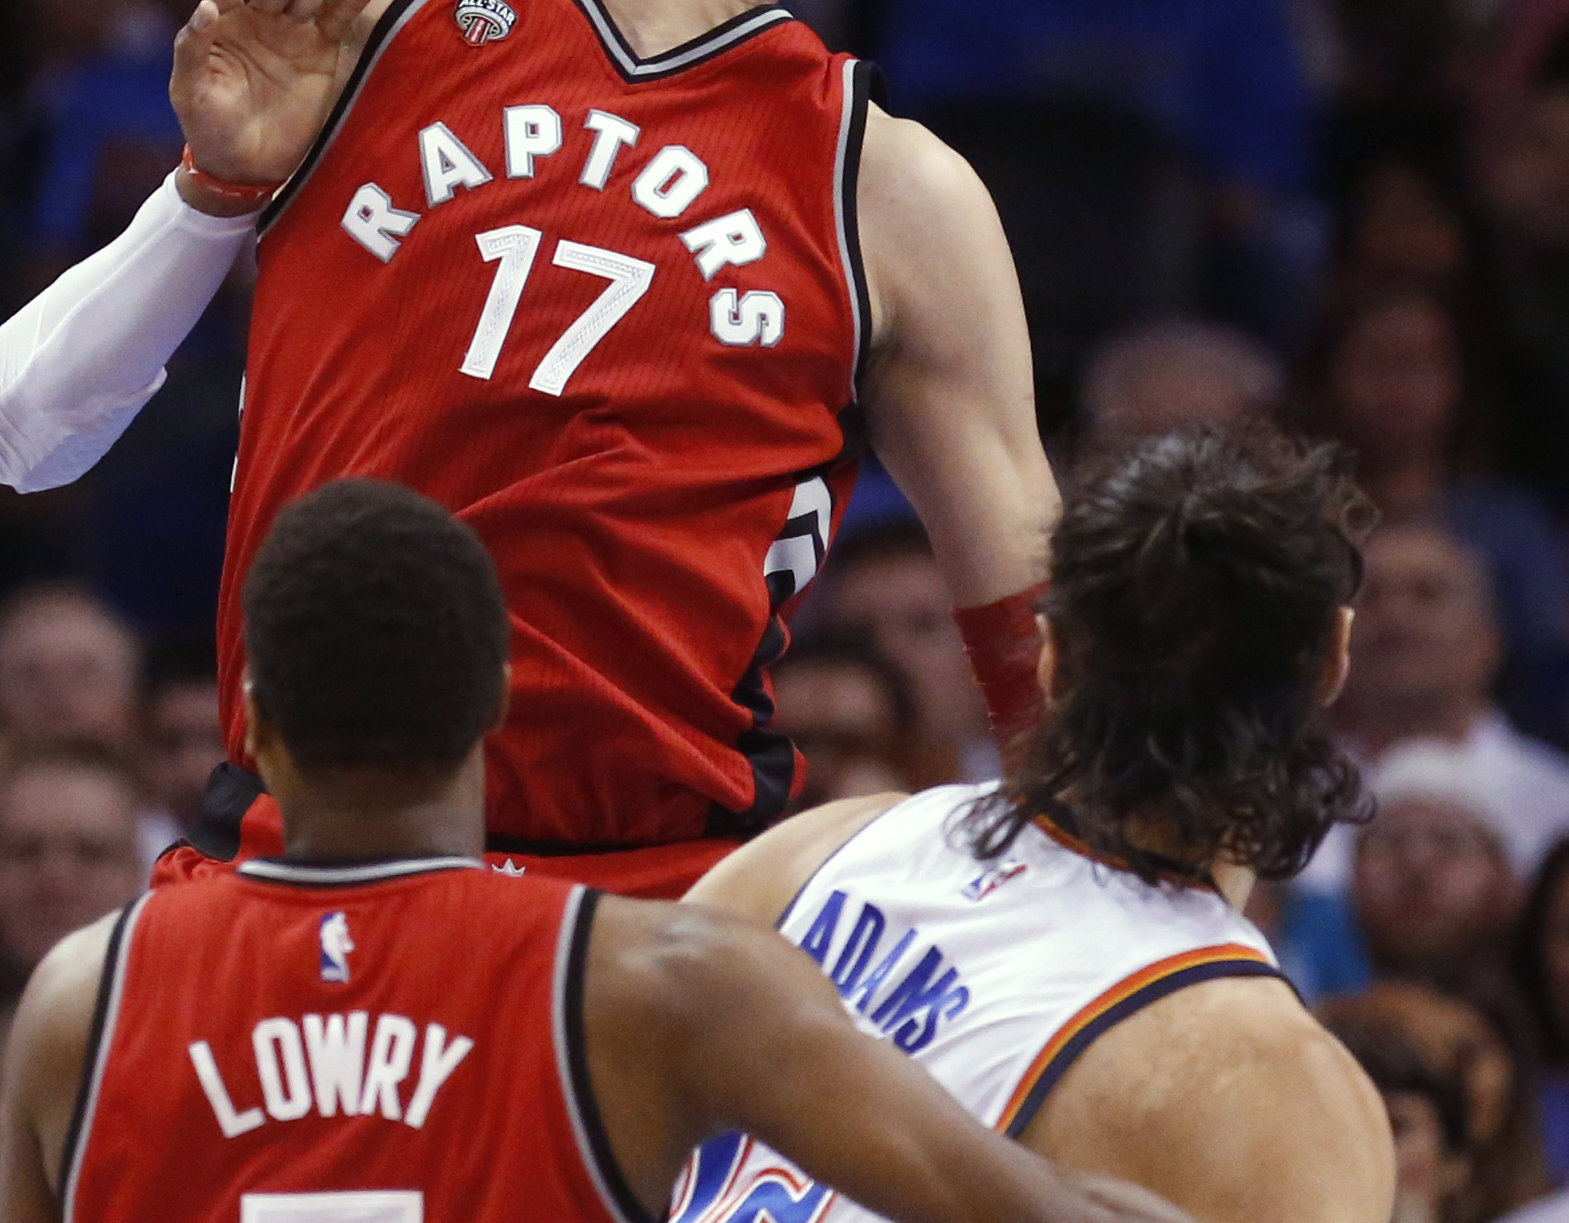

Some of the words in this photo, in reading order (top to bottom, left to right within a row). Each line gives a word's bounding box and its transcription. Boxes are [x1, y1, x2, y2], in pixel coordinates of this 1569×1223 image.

[340, 104, 786, 348] RAPTORS
[458, 224, 657, 397] 17
[800, 890, 969, 1056] ADAMS
[188, 1010, 475, 1139] LOWRY
